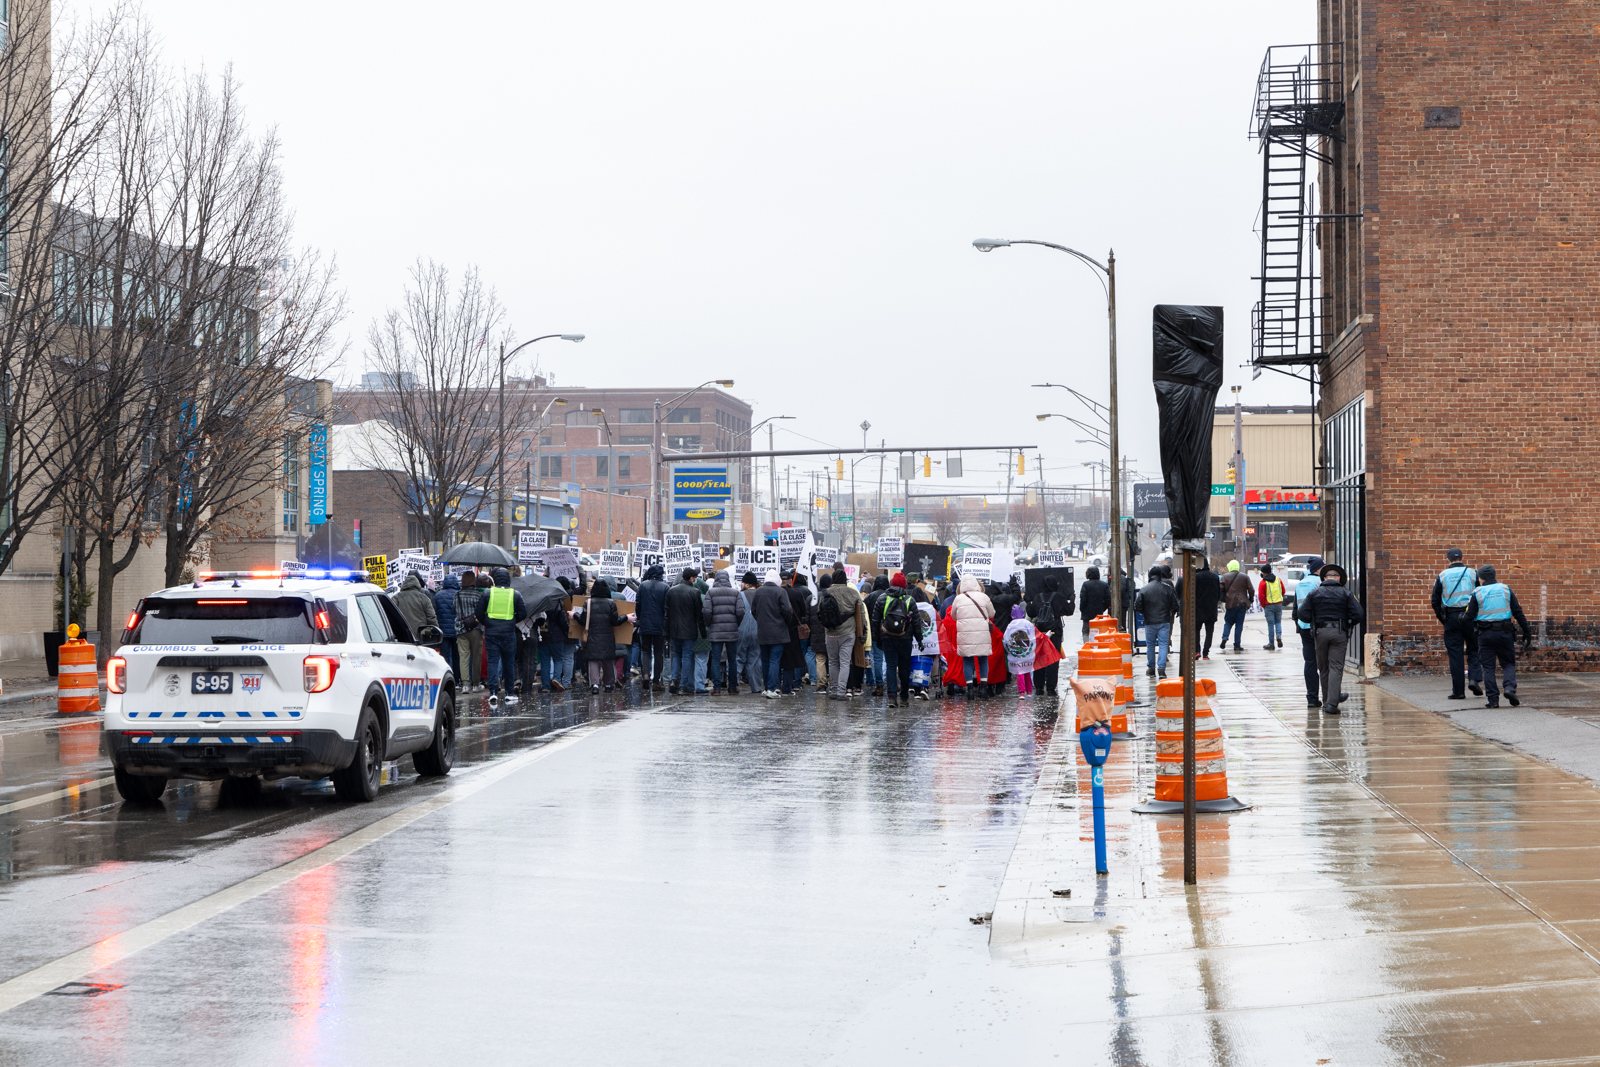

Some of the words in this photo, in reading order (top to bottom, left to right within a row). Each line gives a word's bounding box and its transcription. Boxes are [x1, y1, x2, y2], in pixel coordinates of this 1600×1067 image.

[676, 480, 731, 489] GOODYEAR
[1214, 486, 1227, 494] 3rd
[313, 471, 325, 516] SPRING
[1263, 489, 1319, 502] Tires
[603, 555, 624, 563] UNIDO
[665, 549, 691, 560] UNITED
[750, 549, 776, 564] ICE:
[364, 556, 385, 567] FULL
[405, 562, 430, 571] PLENOS
[964, 557, 992, 565] PLENOS
[386, 561, 400, 576] CE:
[376, 572, 386, 580] ALL
[1009, 660, 1033, 668] MEXICO
[195, 675, 230, 691] S-95
[244, 677, 260, 688] 911
[390, 679, 422, 707] POLICE
[1083, 690, 1114, 702] PARKING
